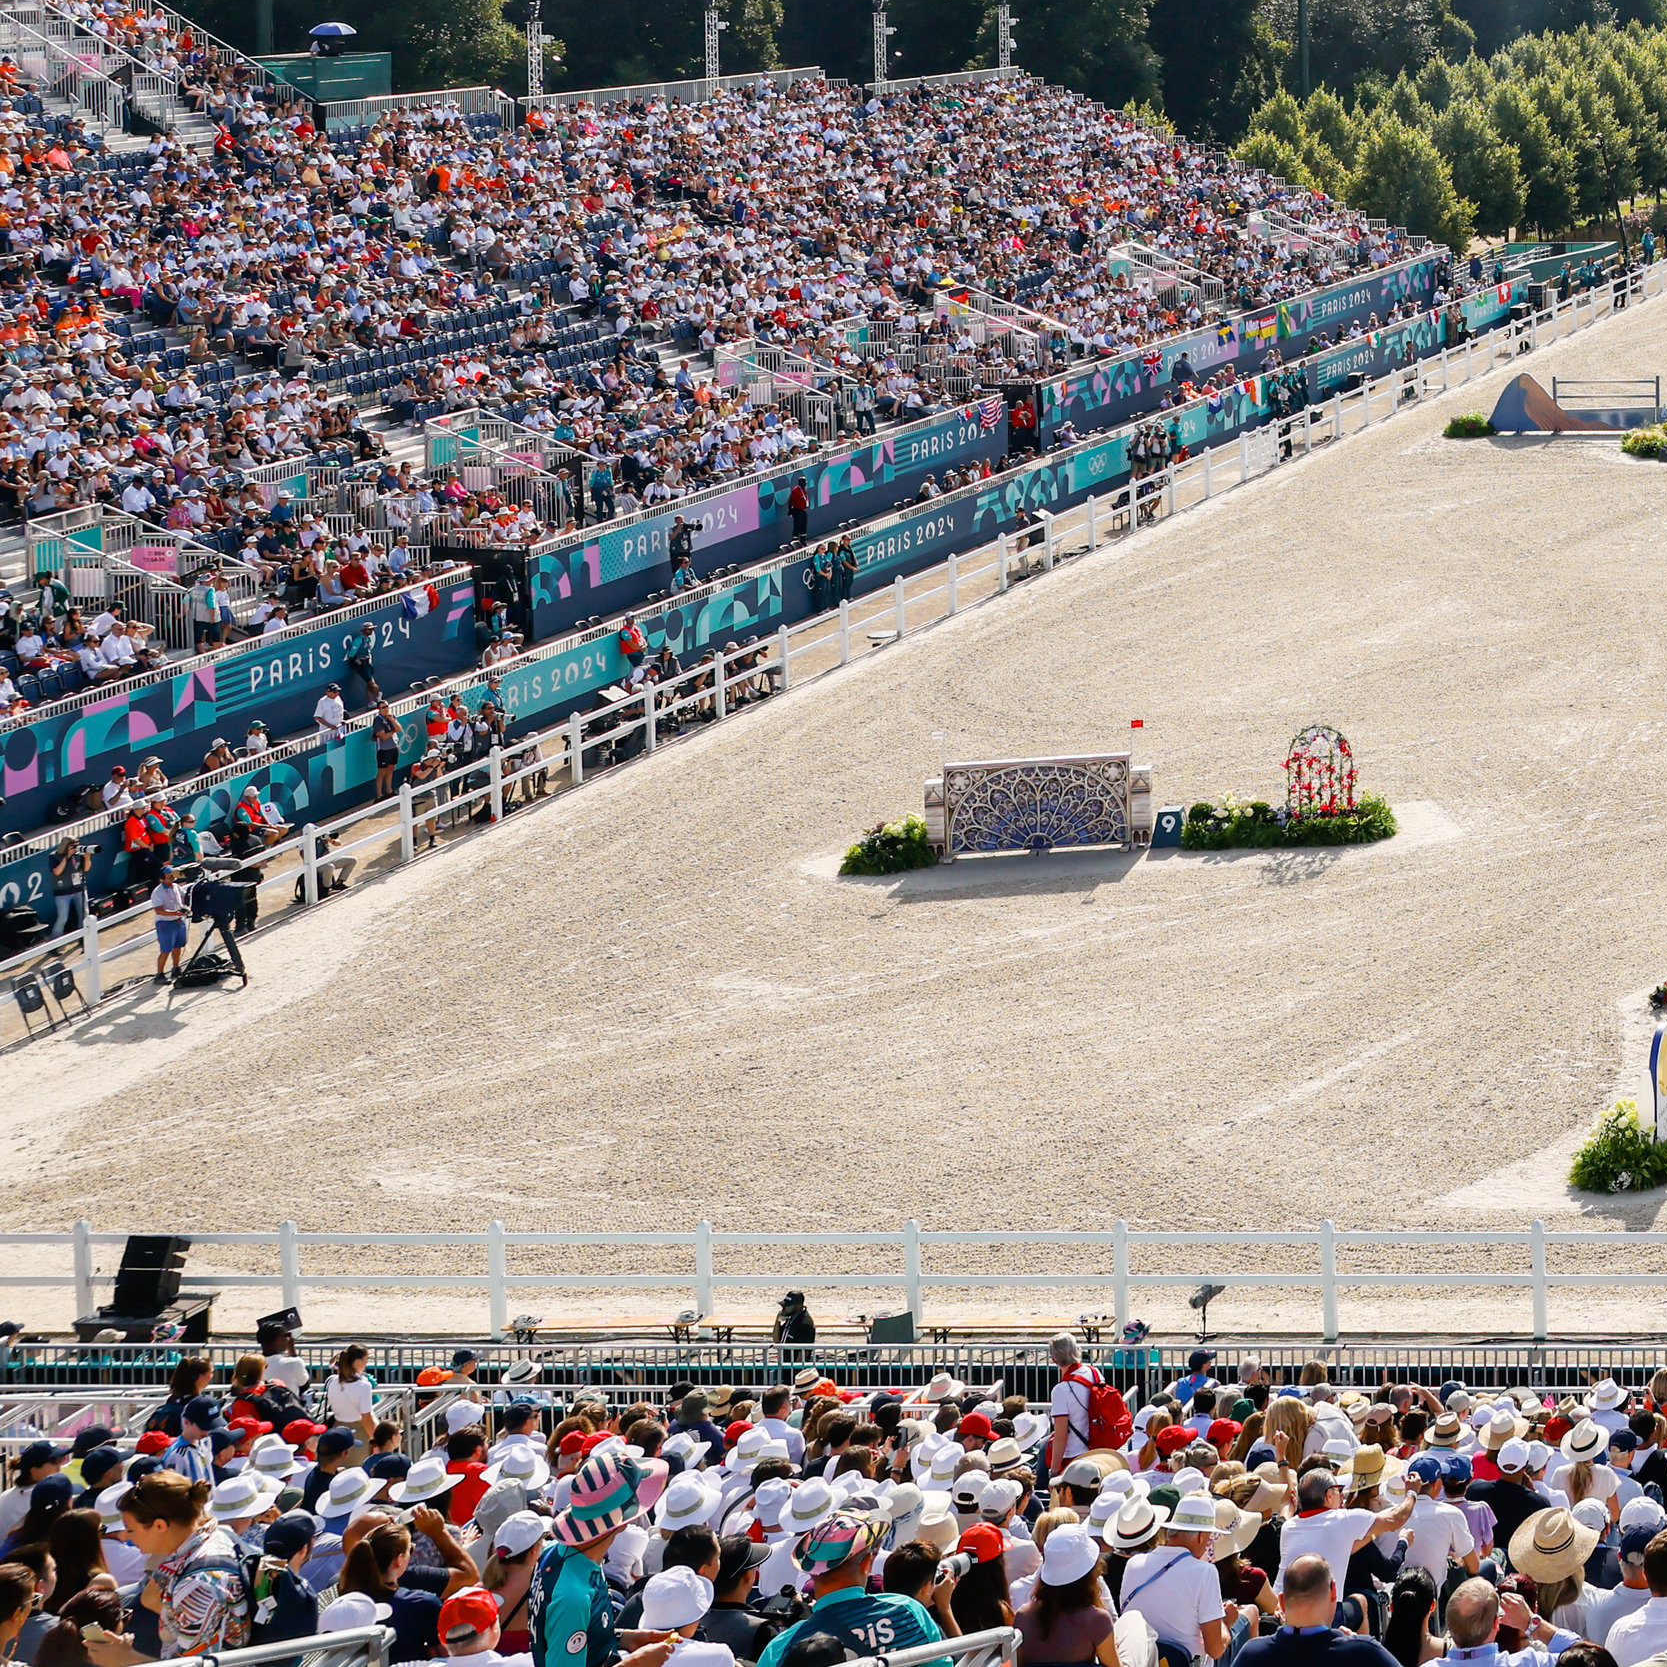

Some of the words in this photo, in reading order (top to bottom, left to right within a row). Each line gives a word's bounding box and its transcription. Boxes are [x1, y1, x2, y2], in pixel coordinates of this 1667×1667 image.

[1348, 288, 1371, 308] 2024
[1353, 348, 1375, 370] 2024
[916, 515, 954, 546] 2024
[552, 652, 606, 692] 2024
[1161, 815, 1176, 833] 9
